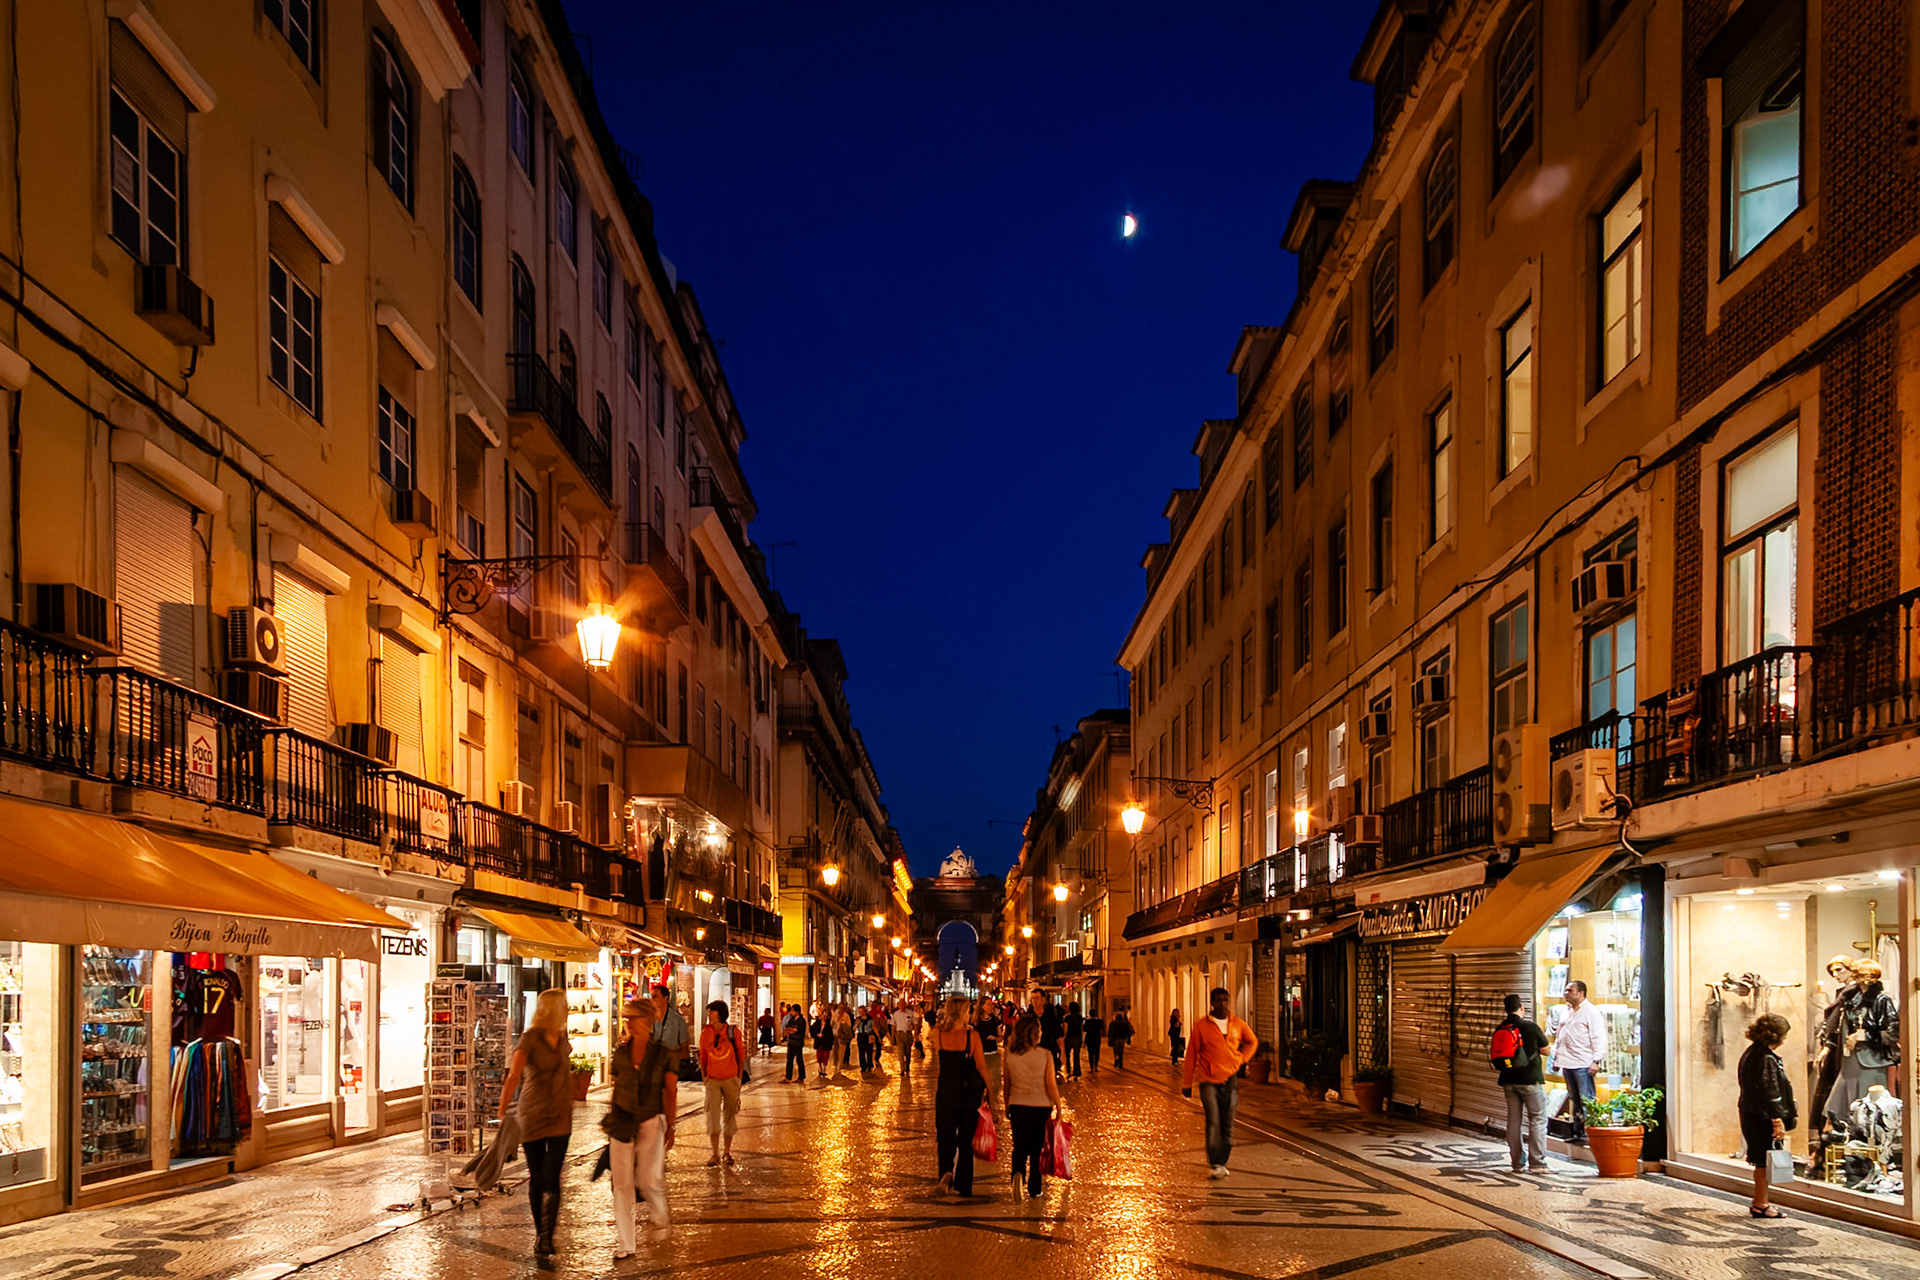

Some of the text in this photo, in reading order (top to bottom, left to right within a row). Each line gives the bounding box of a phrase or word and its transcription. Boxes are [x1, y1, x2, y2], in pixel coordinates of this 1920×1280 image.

[1418, 894, 1459, 931] SANTO
[170, 917, 271, 953] Bijou Brigitte
[203, 987, 225, 1014] 17
